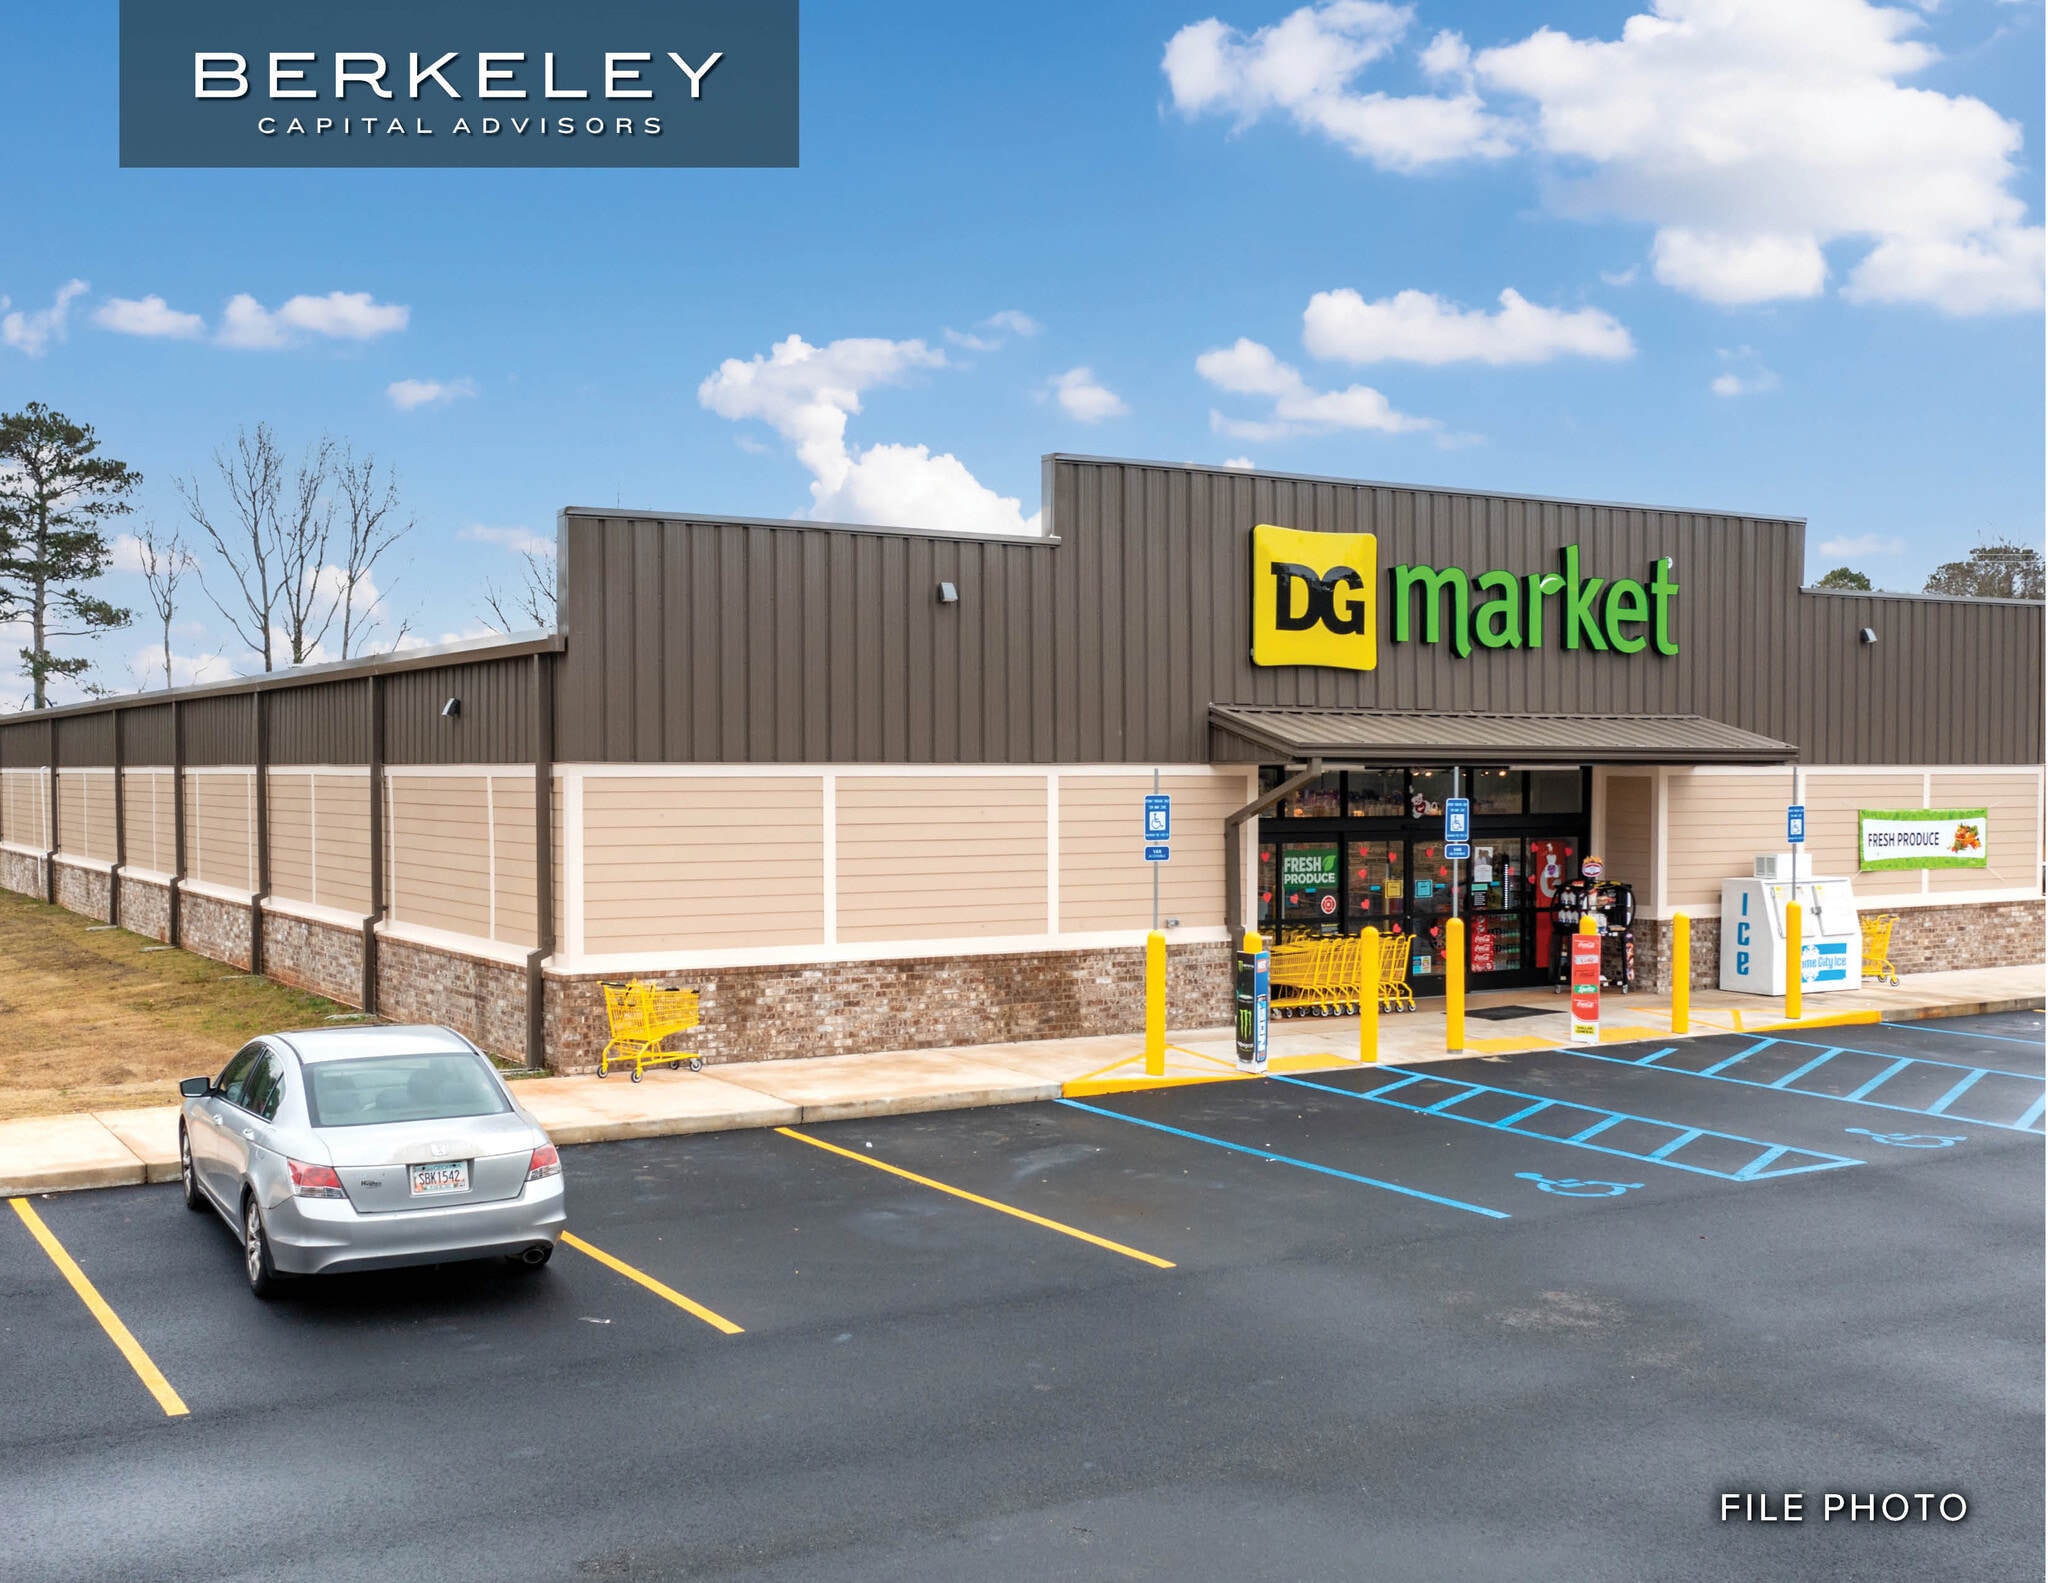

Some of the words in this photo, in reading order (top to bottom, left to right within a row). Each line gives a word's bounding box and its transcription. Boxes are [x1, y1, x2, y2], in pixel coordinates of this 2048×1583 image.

[1271, 561, 1366, 635] DG
[1390, 543, 1680, 658] market
[1867, 832, 1895, 847] FRESH
[1897, 832, 1940, 846] PRODUCE
[1284, 856, 1322, 873] FRESH
[1284, 872, 1336, 885] PRODUCE
[1801, 959, 1817, 969] me
[1818, 956, 1834, 969] City
[418, 1169, 460, 1185] SBK1542
